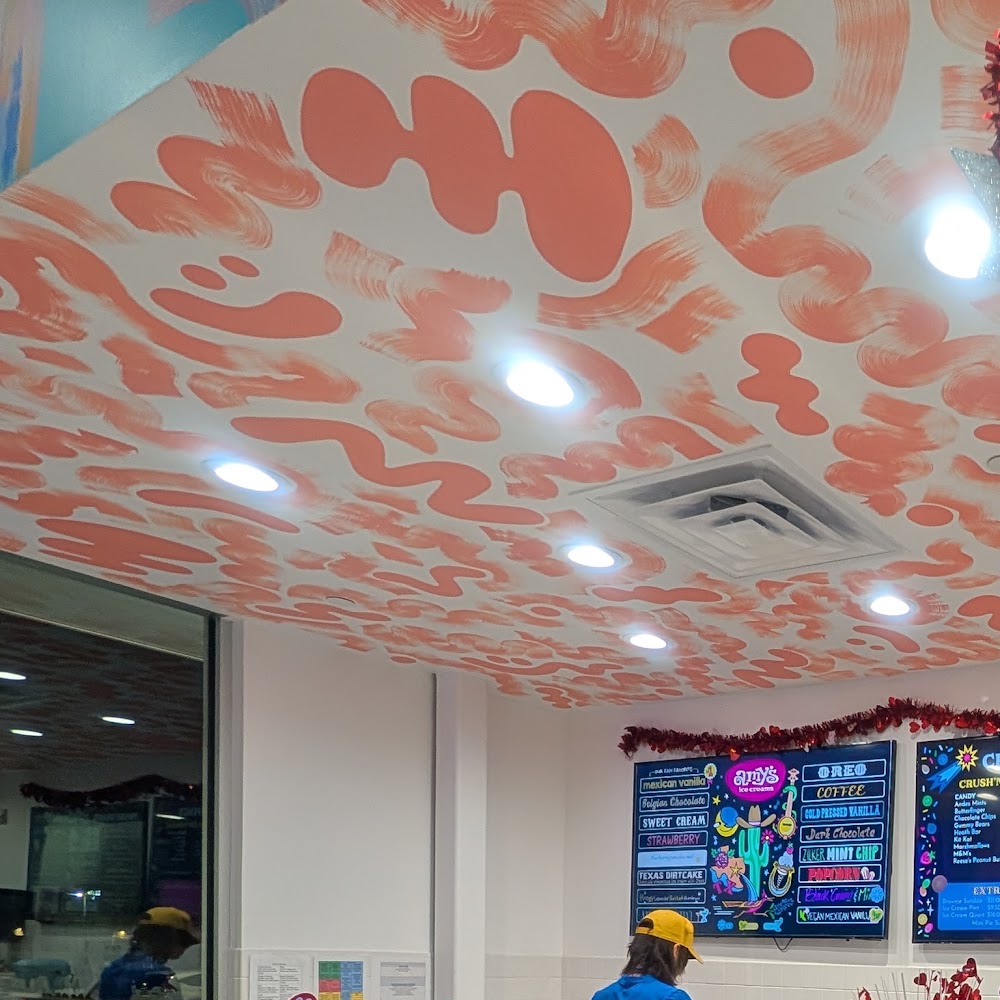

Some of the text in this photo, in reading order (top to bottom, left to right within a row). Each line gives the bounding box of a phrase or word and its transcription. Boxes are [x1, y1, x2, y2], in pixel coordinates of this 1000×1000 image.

[818, 763, 867, 778] OREO
[643, 777, 706, 789] mexican vanilla
[817, 784, 866, 798] COFFEE
[642, 796, 705, 810] Belgian Chocolate
[642, 815, 706, 828] SWEET CREAM
[647, 834, 701, 846] STRAWBERRY
[805, 826, 875, 840] Dark Chocolate
[827, 847, 854, 860] MINT
[856, 845, 879, 860] CHIP
[640, 871, 703, 880] TEXAS DIRTCAKE
